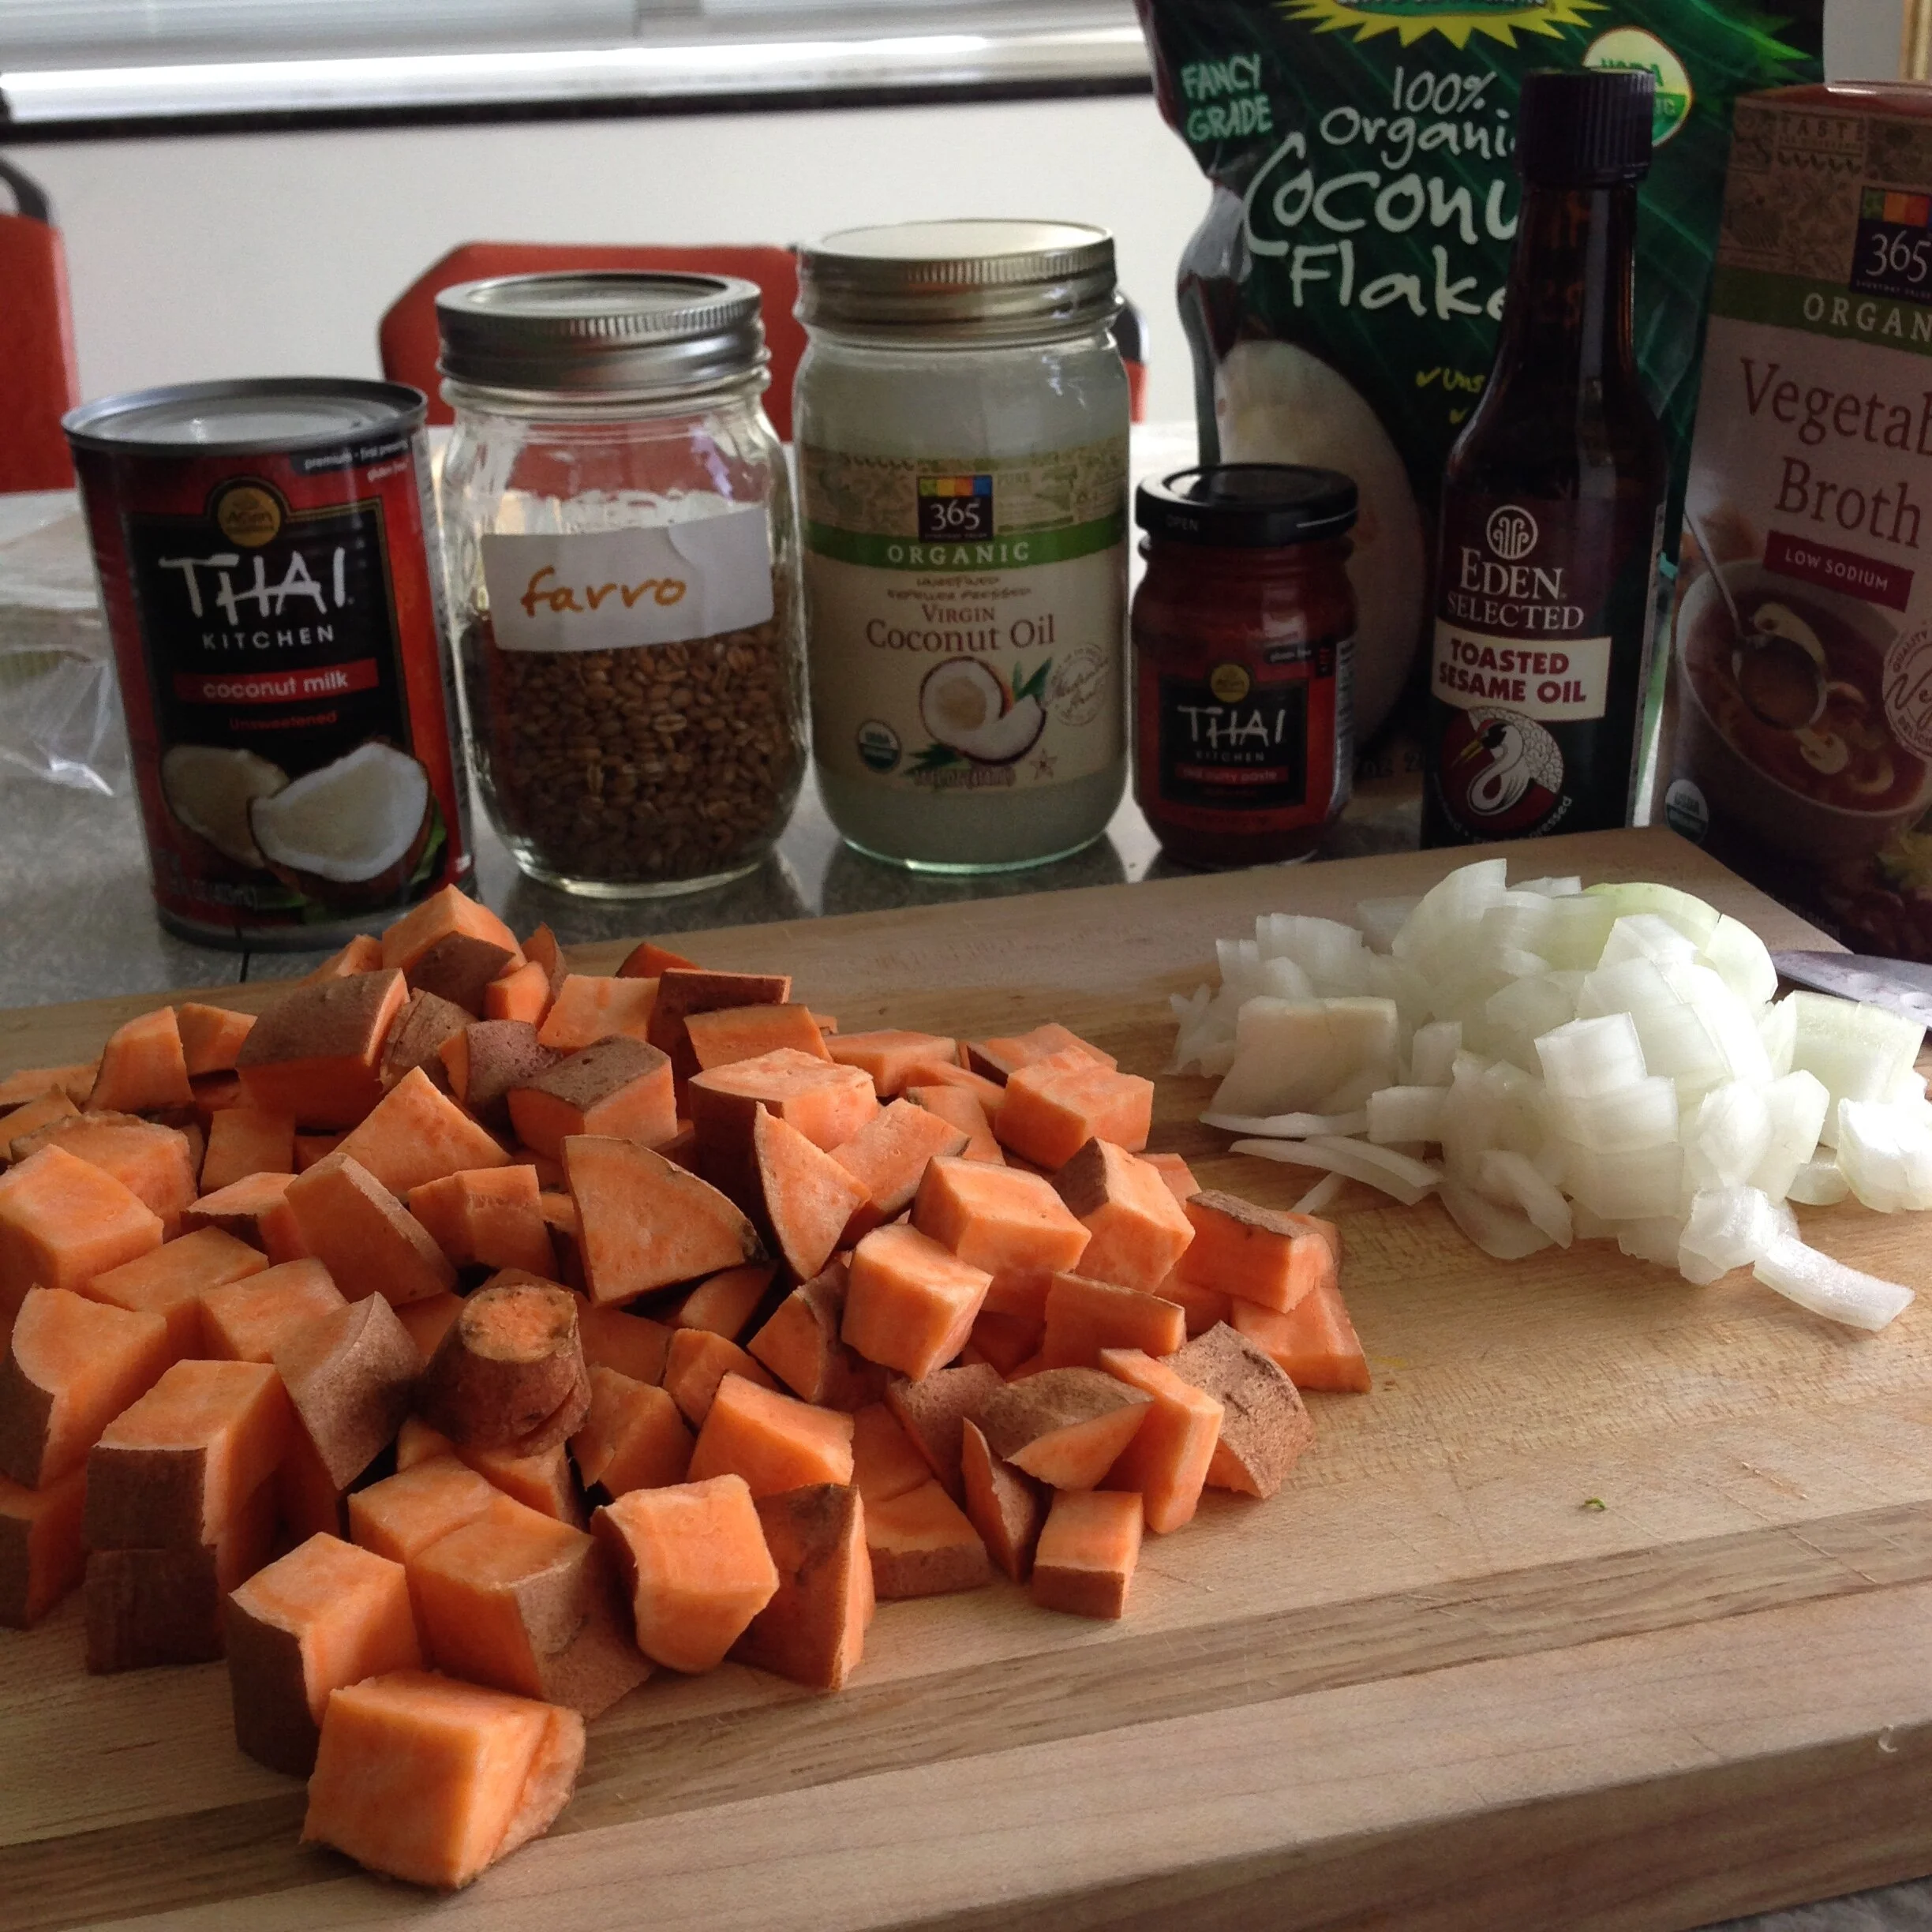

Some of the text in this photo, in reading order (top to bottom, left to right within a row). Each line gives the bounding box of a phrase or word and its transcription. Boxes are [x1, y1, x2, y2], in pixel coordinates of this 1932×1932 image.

[1181, 52, 1262, 102] FANCY
[1392, 66, 1499, 114] 100%
[1187, 92, 1274, 143] GRADE
[1320, 107, 1517, 170] Organi
[1243, 130, 1520, 257] Coconu
[1290, 238, 1507, 321] Flake
[1865, 230, 1932, 283] 365
[1803, 292, 1932, 343] ORGAN
[930, 499, 980, 531] 365
[1775, 455, 1921, 550] Broth
[887, 541, 1030, 565] ORGANIC
[1459, 545, 1565, 601] EDEN
[1784, 546, 1889, 592] LOW SODIUM
[158, 546, 346, 626] THAI
[520, 564, 687, 619] farro
[867, 613, 1056, 652] Coconut Oil
[1447, 590, 1586, 631] SELECTED
[201, 623, 335, 650] KITCHEN
[1451, 638, 1570, 676] TOASTED
[203, 669, 350, 698] coconut milk
[1439, 661, 1587, 704] SESAME OIL
[1176, 704, 1287, 750] THAI
[1195, 750, 1265, 763] KITCHEN
